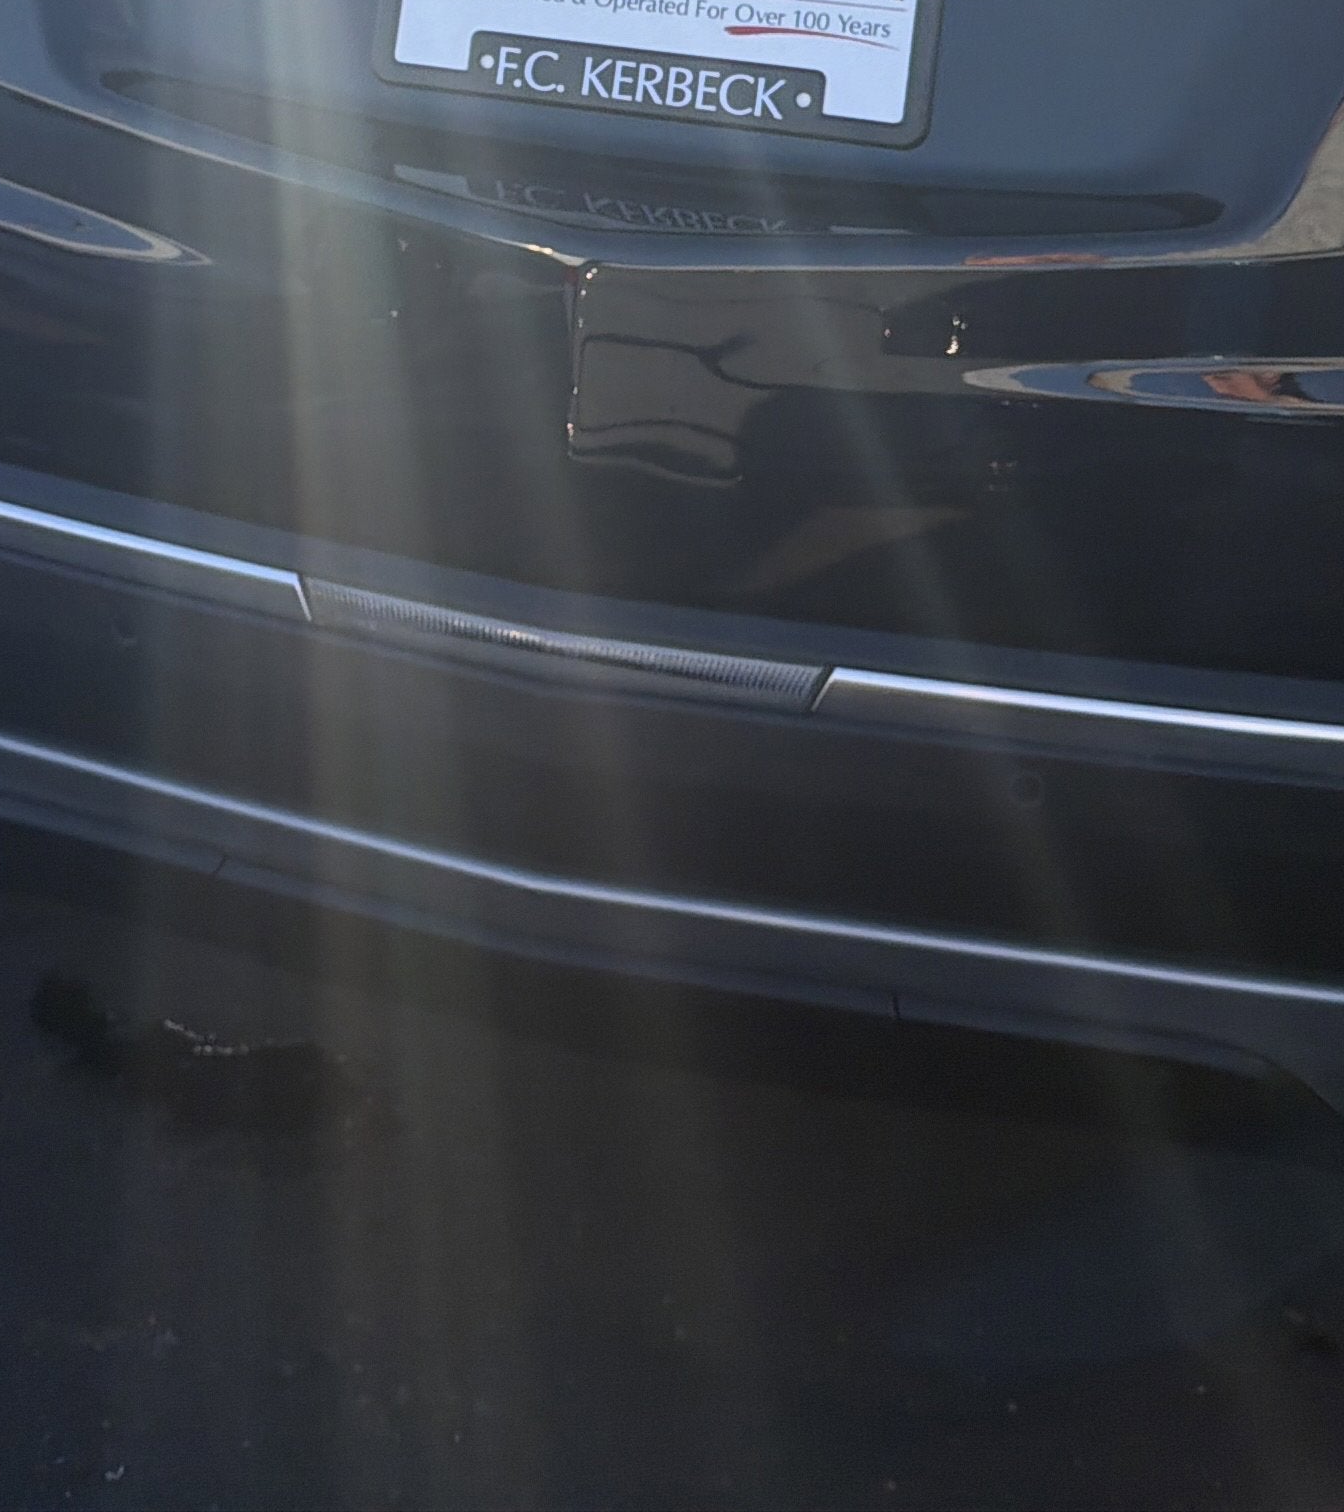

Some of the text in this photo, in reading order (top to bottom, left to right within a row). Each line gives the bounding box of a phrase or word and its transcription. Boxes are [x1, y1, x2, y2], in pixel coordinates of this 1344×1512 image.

[735, 3, 787, 26] Over
[794, 10, 831, 31] 100
[838, 13, 892, 38] Years
[495, 46, 787, 120] F.C. KERBECK
